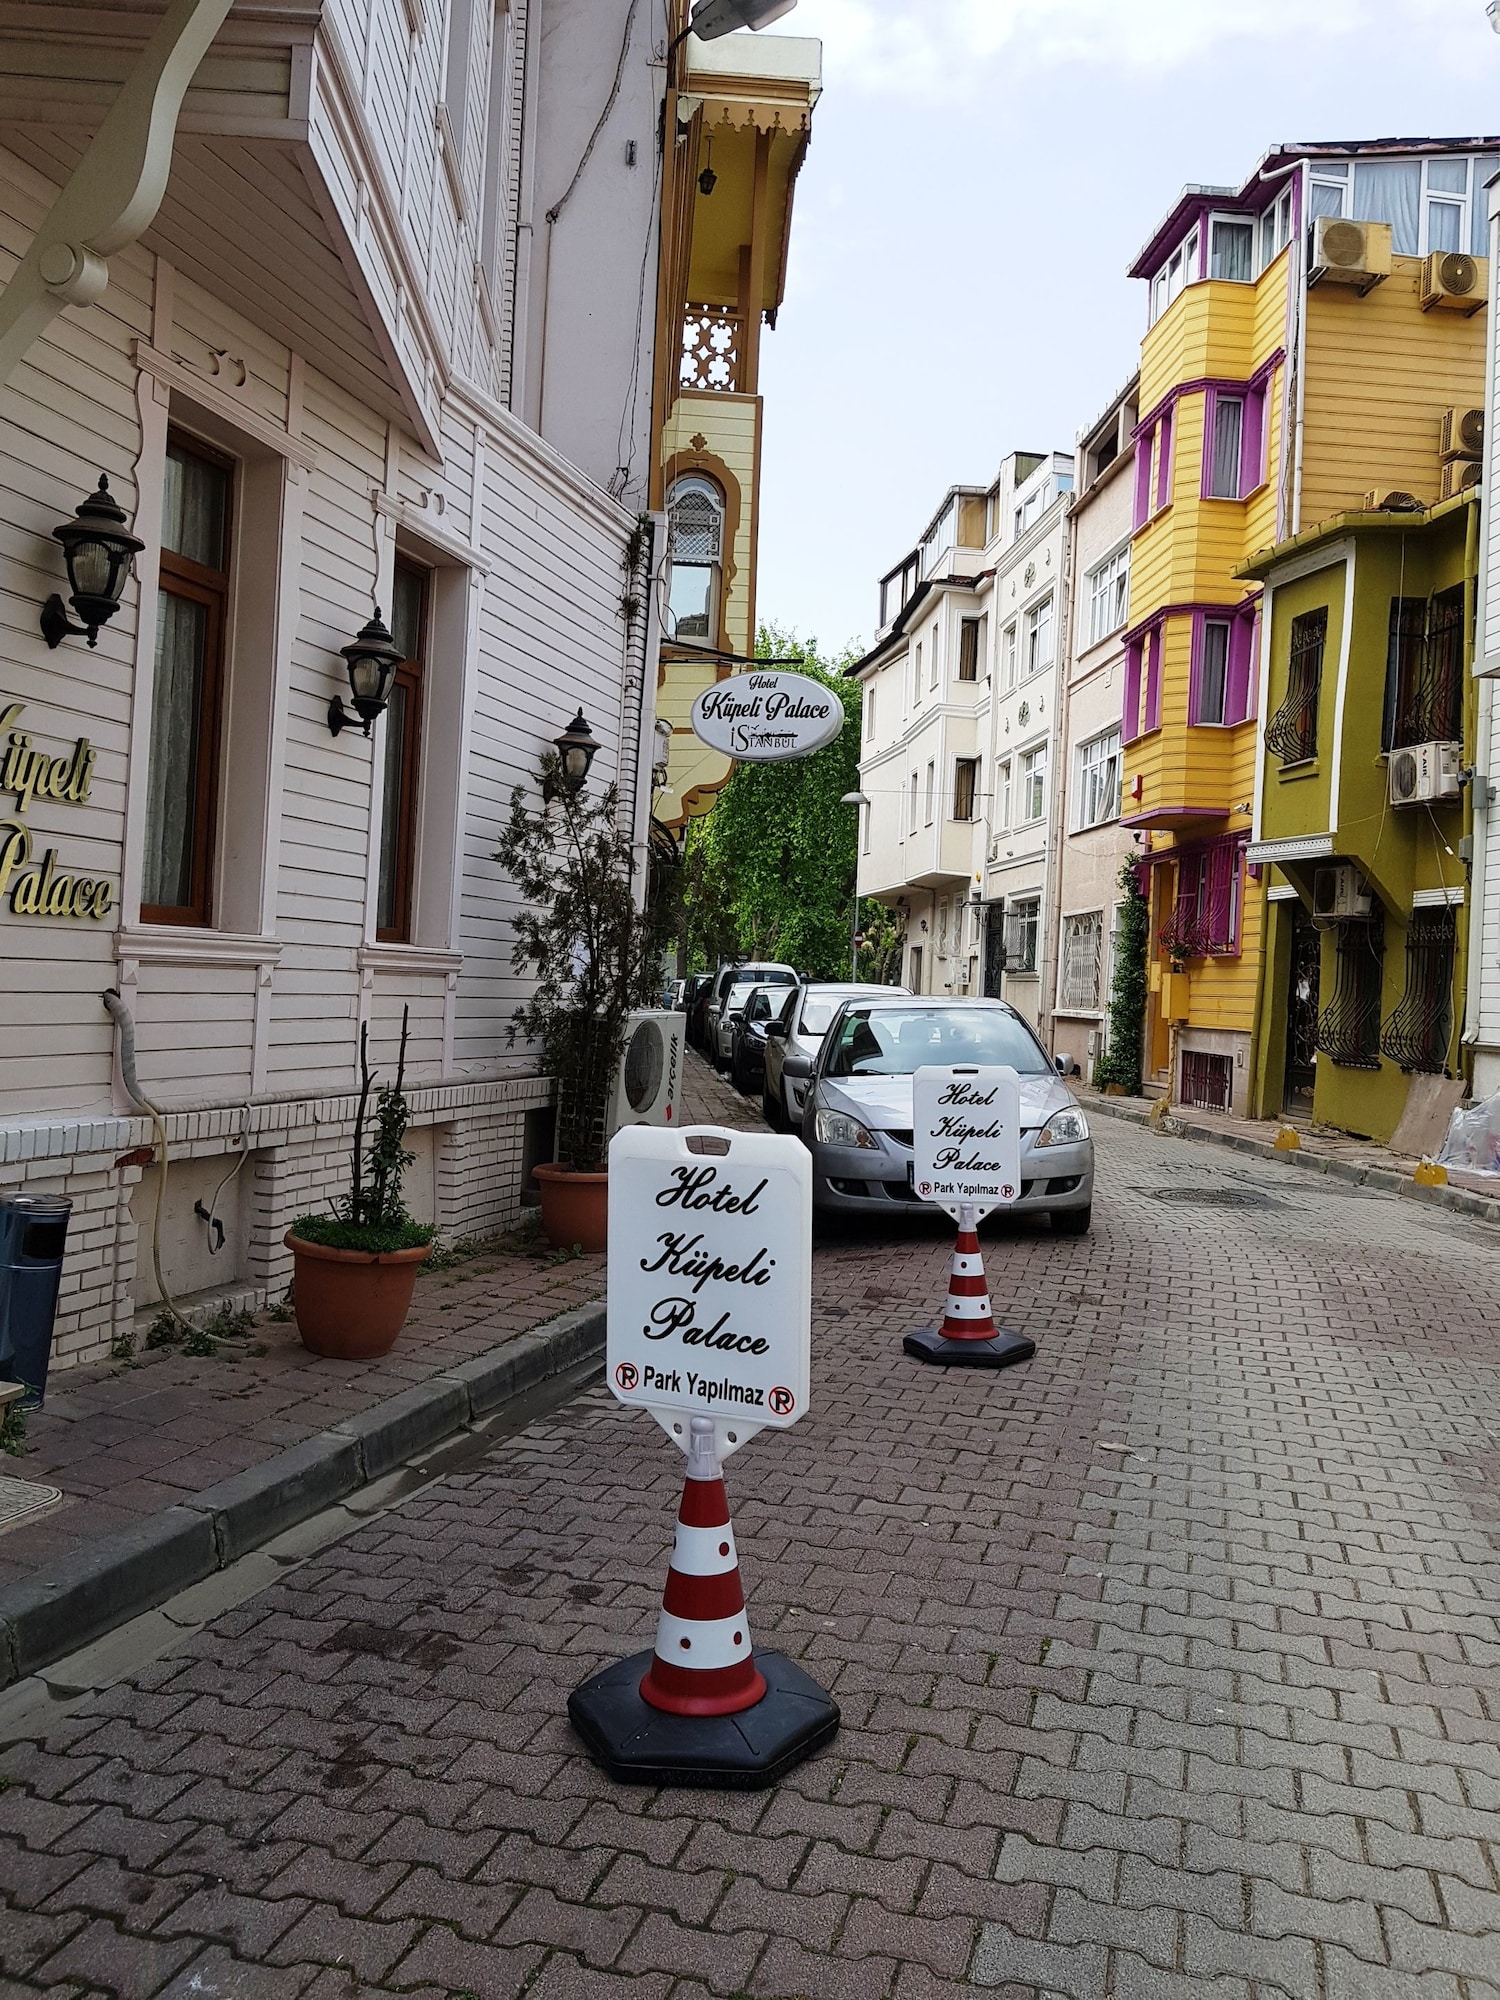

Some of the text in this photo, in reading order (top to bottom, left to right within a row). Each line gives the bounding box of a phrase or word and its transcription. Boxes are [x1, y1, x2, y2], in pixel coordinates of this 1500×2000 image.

[749, 675, 778, 690] Hotel
[701, 691, 830, 723] Küpeli Palace
[0, 703, 97, 812] üpeli
[938, 1084, 998, 1105] Hotel
[930, 1116, 1003, 1145] Küpeli
[933, 1148, 1001, 1171] Palace
[656, 1166, 768, 1215] Hotel
[934, 1182, 954, 1193] Park
[957, 1183, 999, 1196] Yapılmaz
[640, 1232, 776, 1293] Küpeli
[643, 1297, 770, 1355] Palace
[644, 1365, 681, 1393] Park
[687, 1371, 764, 1406] Yapılmaz
